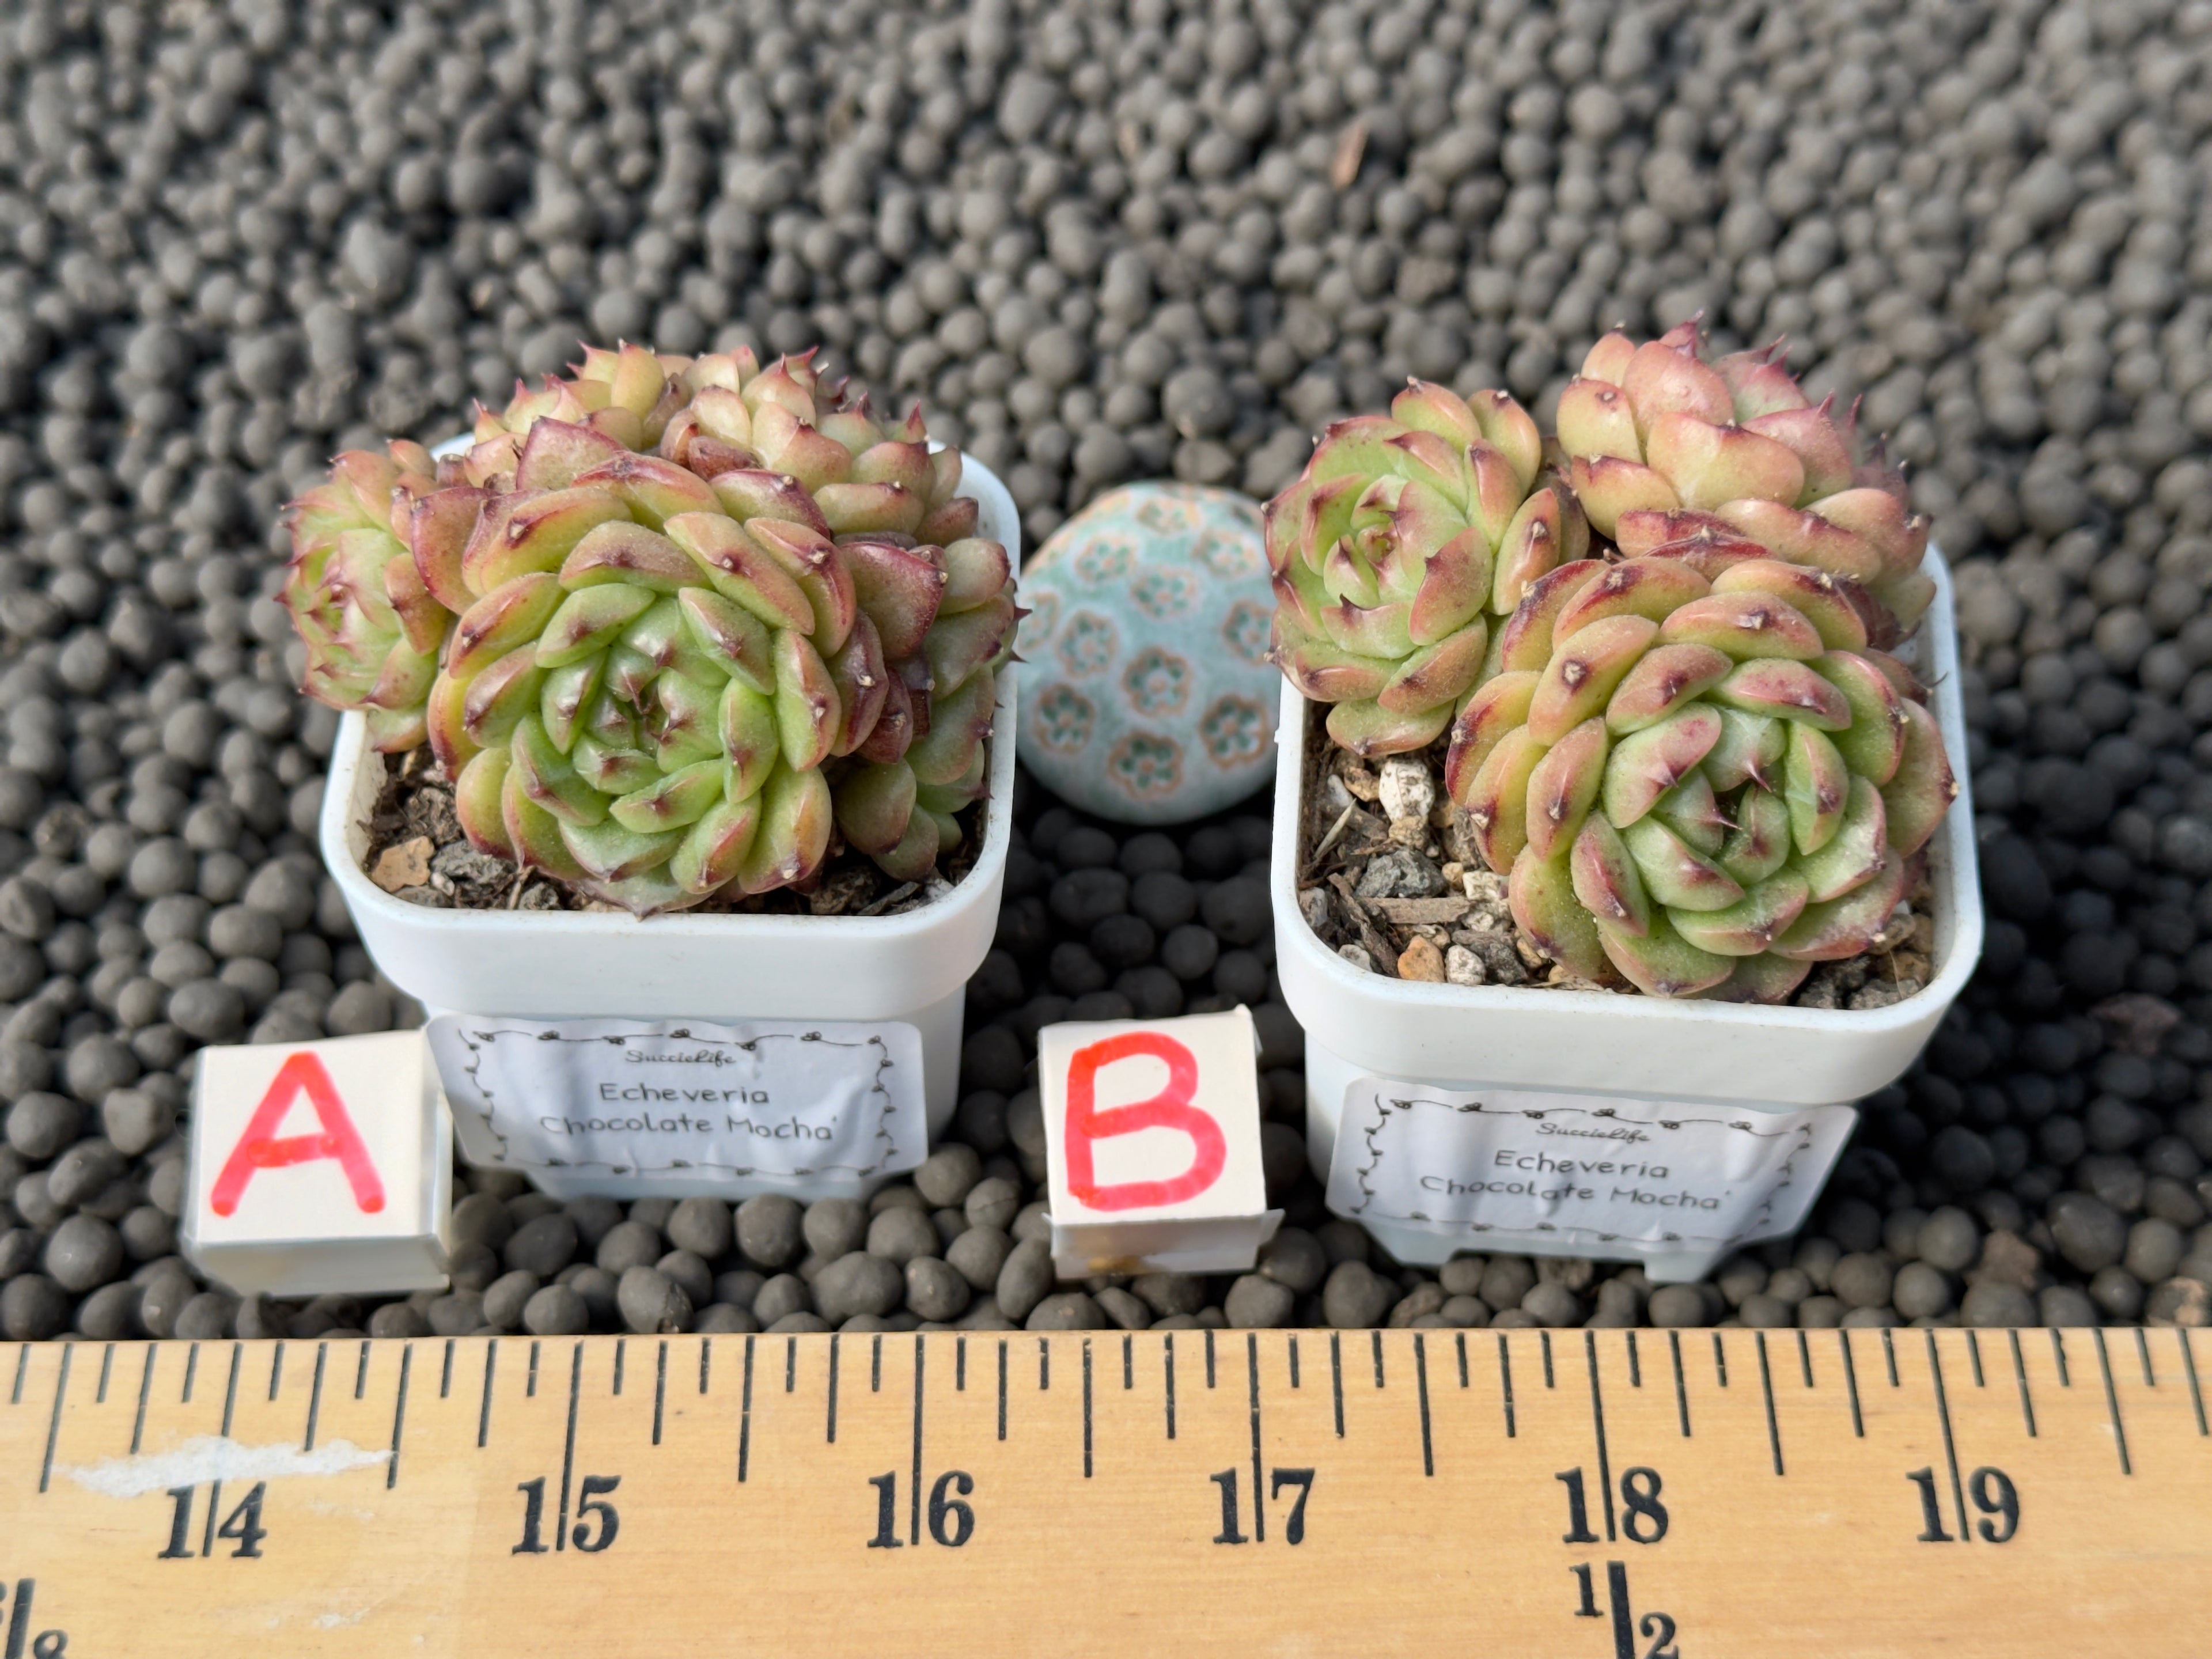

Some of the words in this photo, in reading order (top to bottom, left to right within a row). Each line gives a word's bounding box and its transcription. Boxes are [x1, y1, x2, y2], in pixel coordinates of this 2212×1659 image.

[599, 1082, 770, 1104] Echeveria
[210, 1050, 387, 1218] A
[540, 1112, 713, 1136] Chocolate
[1064, 1030, 1228, 1213] B
[1494, 1149, 1670, 1179] Echeveria
[1419, 1175, 1594, 1200] Chocolate
[512, 1474, 622, 1555] 15
[867, 1470, 975, 1548] 16
[1209, 1467, 1316, 1545] 17
[1555, 1465, 1669, 1544] 18
[1906, 1465, 2020, 1544] 19
